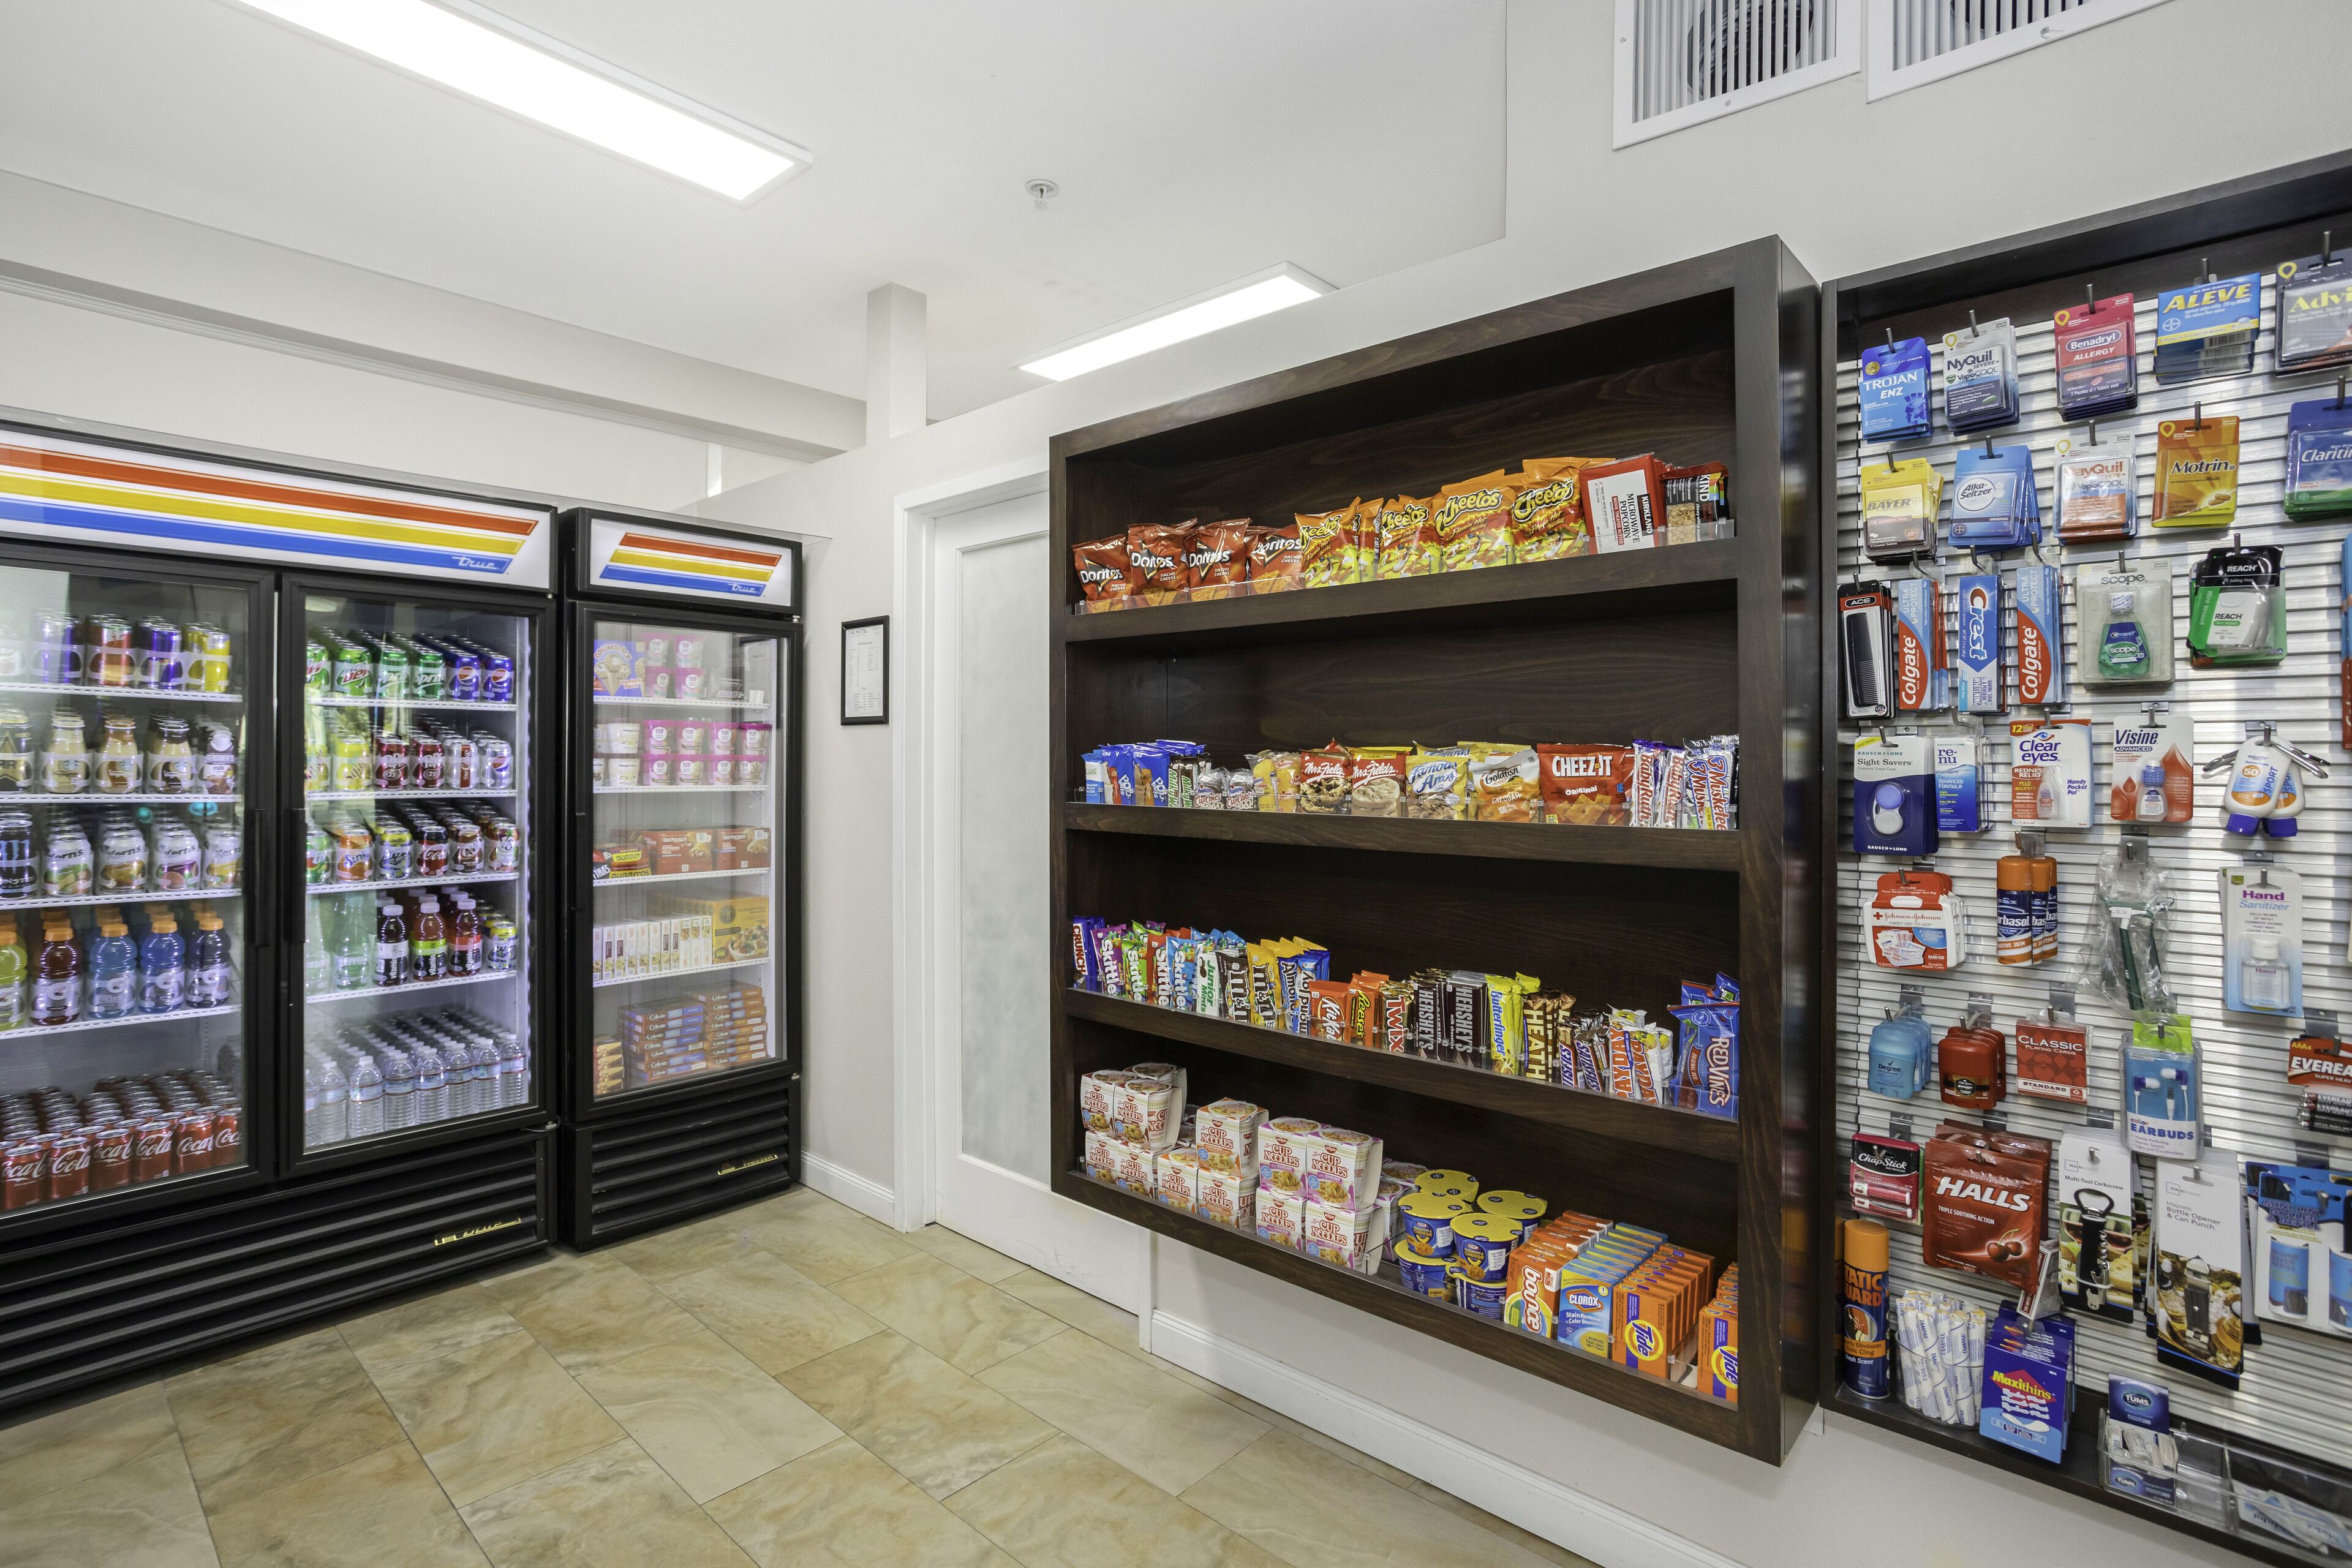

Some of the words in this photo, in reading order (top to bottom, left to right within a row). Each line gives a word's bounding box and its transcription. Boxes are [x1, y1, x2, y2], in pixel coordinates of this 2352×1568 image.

[2163, 284, 2252, 314] ALEVE
[2289, 286, 2352, 312] Advi
[2070, 333, 2116, 350] Benadryl
[1947, 350, 1993, 371] NyQuil
[2073, 347, 2115, 361] ALLERGY
[1863, 371, 1917, 391] TROJAN
[1958, 368, 1998, 380] VapoCOOL
[1880, 386, 1904, 399] ENZ
[2171, 458, 2229, 475] Motrin
[1699, 473, 1709, 502] KIND
[1960, 488, 1993, 500] Seltzer
[1512, 480, 1574, 522] Cheetos
[1867, 498, 1912, 511] BAYER
[1435, 489, 1503, 537] Cheetos
[1619, 500, 1631, 538] POPCORN
[1626, 493, 1641, 543] MICROWAVE
[1640, 496, 1654, 534] KIRKLAND
[1131, 552, 1173, 568] Doritos
[1189, 550, 1231, 567] Doritos
[1080, 567, 1123, 583] Doritos
[2101, 574, 2145, 585] scope
[1969, 587, 1988, 660] Crest
[2199, 605, 2209, 626] Waxed
[1902, 636, 1920, 705] Colgate
[2021, 627, 2042, 699] Colgate
[1973, 676, 1982, 706] WHITENING
[2012, 725, 2023, 733] 12
[2116, 729, 2159, 745] Visine
[2019, 740, 2061, 752] Clear
[2021, 752, 2059, 765] eyes
[1411, 761, 1458, 783] Famous
[1422, 772, 1456, 788] Amos
[1485, 765, 1520, 785] Goldfish
[2263, 766, 2278, 794] SPORT
[1565, 786, 1598, 796] ORIGINAL
[2239, 900, 2290, 911] Sanitizer
[2242, 890, 2285, 901] Hand
[1073, 925, 1087, 974] CRUNCH
[1101, 938, 1117, 996] Skittle
[1127, 949, 1142, 1001] Skittle
[1206, 960, 1216, 1006] Junior
[1385, 994, 1406, 1052] TWIX
[1419, 989, 1434, 1051] HERSHEY'S
[1455, 987, 1473, 1054] HERSHEY'S
[1490, 990, 1507, 1057] Butterfinger
[1524, 1007, 1547, 1080] HEATH
[2018, 1035, 2083, 1051] CLASSIC
[1878, 1063, 1901, 1072] Degree
[2291, 1056, 2352, 1077] EVEREA
[2023, 1082, 2067, 1091] STANDARD
[2130, 1123, 2194, 1140] EARBUDS
[1264, 1150, 1300, 1167] NOODLES
[1272, 1144, 1292, 1157] CUP
[1321, 1153, 1341, 1167] CUP
[1311, 1159, 1348, 1178] NOODLES
[1858, 1153, 1907, 1170] ChapStick
[2065, 1175, 2093, 1185] Multi-Tool
[2094, 1180, 2124, 1191] Corkscrew
[1936, 1176, 2031, 1212] HALLS
[1938, 1205, 1953, 1215] TRIPLE
[1953, 1208, 1977, 1220] SOOTHING
[1977, 1216, 1995, 1225] ACTION
[2166, 1206, 2190, 1217] Bottle
[2191, 1213, 2221, 1225] Opener
[2191, 1218, 2215, 1231] Punch
[1845, 1265, 1883, 1291] TATIC
[1520, 1264, 1542, 1333] bounce
[1579, 1313, 1605, 1322] Remover
[1632, 1322, 1654, 1356] Tide
[1920, 1319, 1928, 1340] TAMPAX
[1992, 1370, 2052, 1400] Maxithins
[1943, 1387, 1952, 1407] TAMPAX
[2125, 1394, 2149, 1406] TUMS
